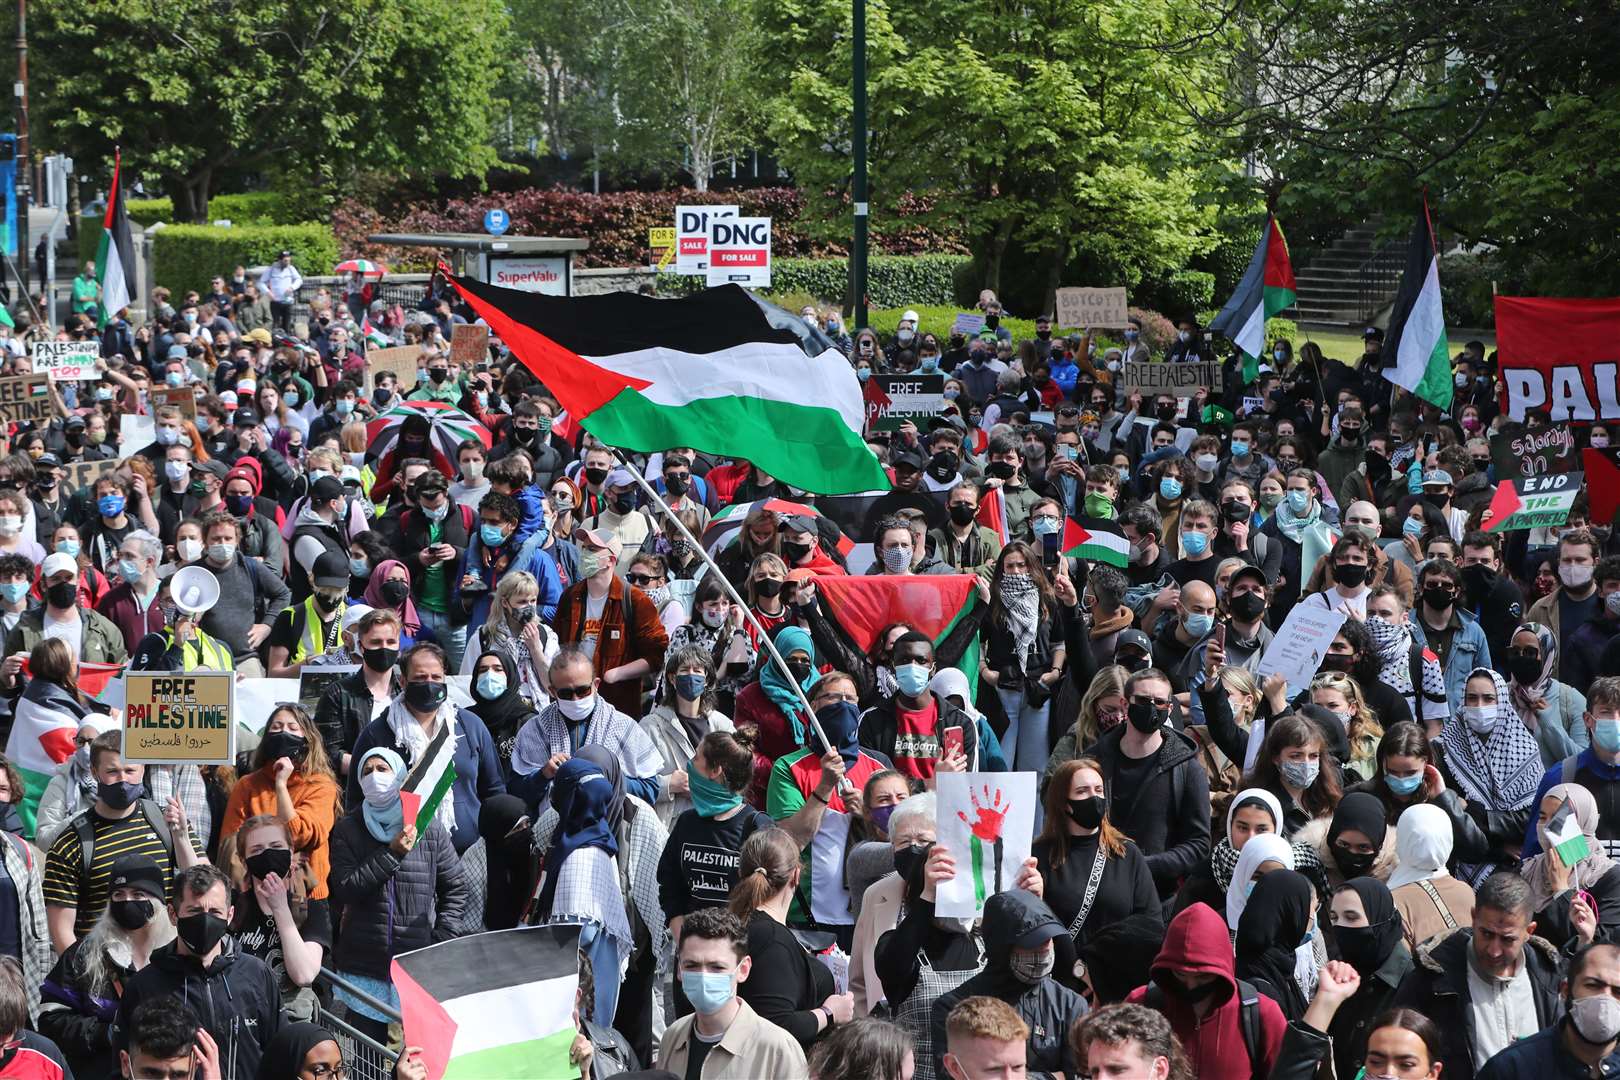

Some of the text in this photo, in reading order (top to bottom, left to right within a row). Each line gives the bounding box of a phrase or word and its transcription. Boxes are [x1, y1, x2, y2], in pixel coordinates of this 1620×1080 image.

[651, 230, 666, 239] FOR
[712, 224, 767, 245] DNG
[497, 271, 557, 285] SuperValu
[1061, 293, 1124, 307] BOYCOTT
[1062, 309, 1120, 323] ISRAEL
[37, 356, 58, 367] ARE
[51, 366, 80, 377] TOO
[889, 382, 922, 396] FREE
[869, 401, 942, 418] PALESTINE
[1520, 455, 1548, 477] an
[1523, 475, 1568, 491] END
[1526, 496, 1562, 510] THE
[151, 678, 197, 703] FREE
[127, 703, 228, 729] PALESTINE
[894, 740, 938, 751] Random
[683, 850, 740, 867] PALESTINE
[1082, 885, 1097, 908] JEANS
[239, 926, 265, 950] only
